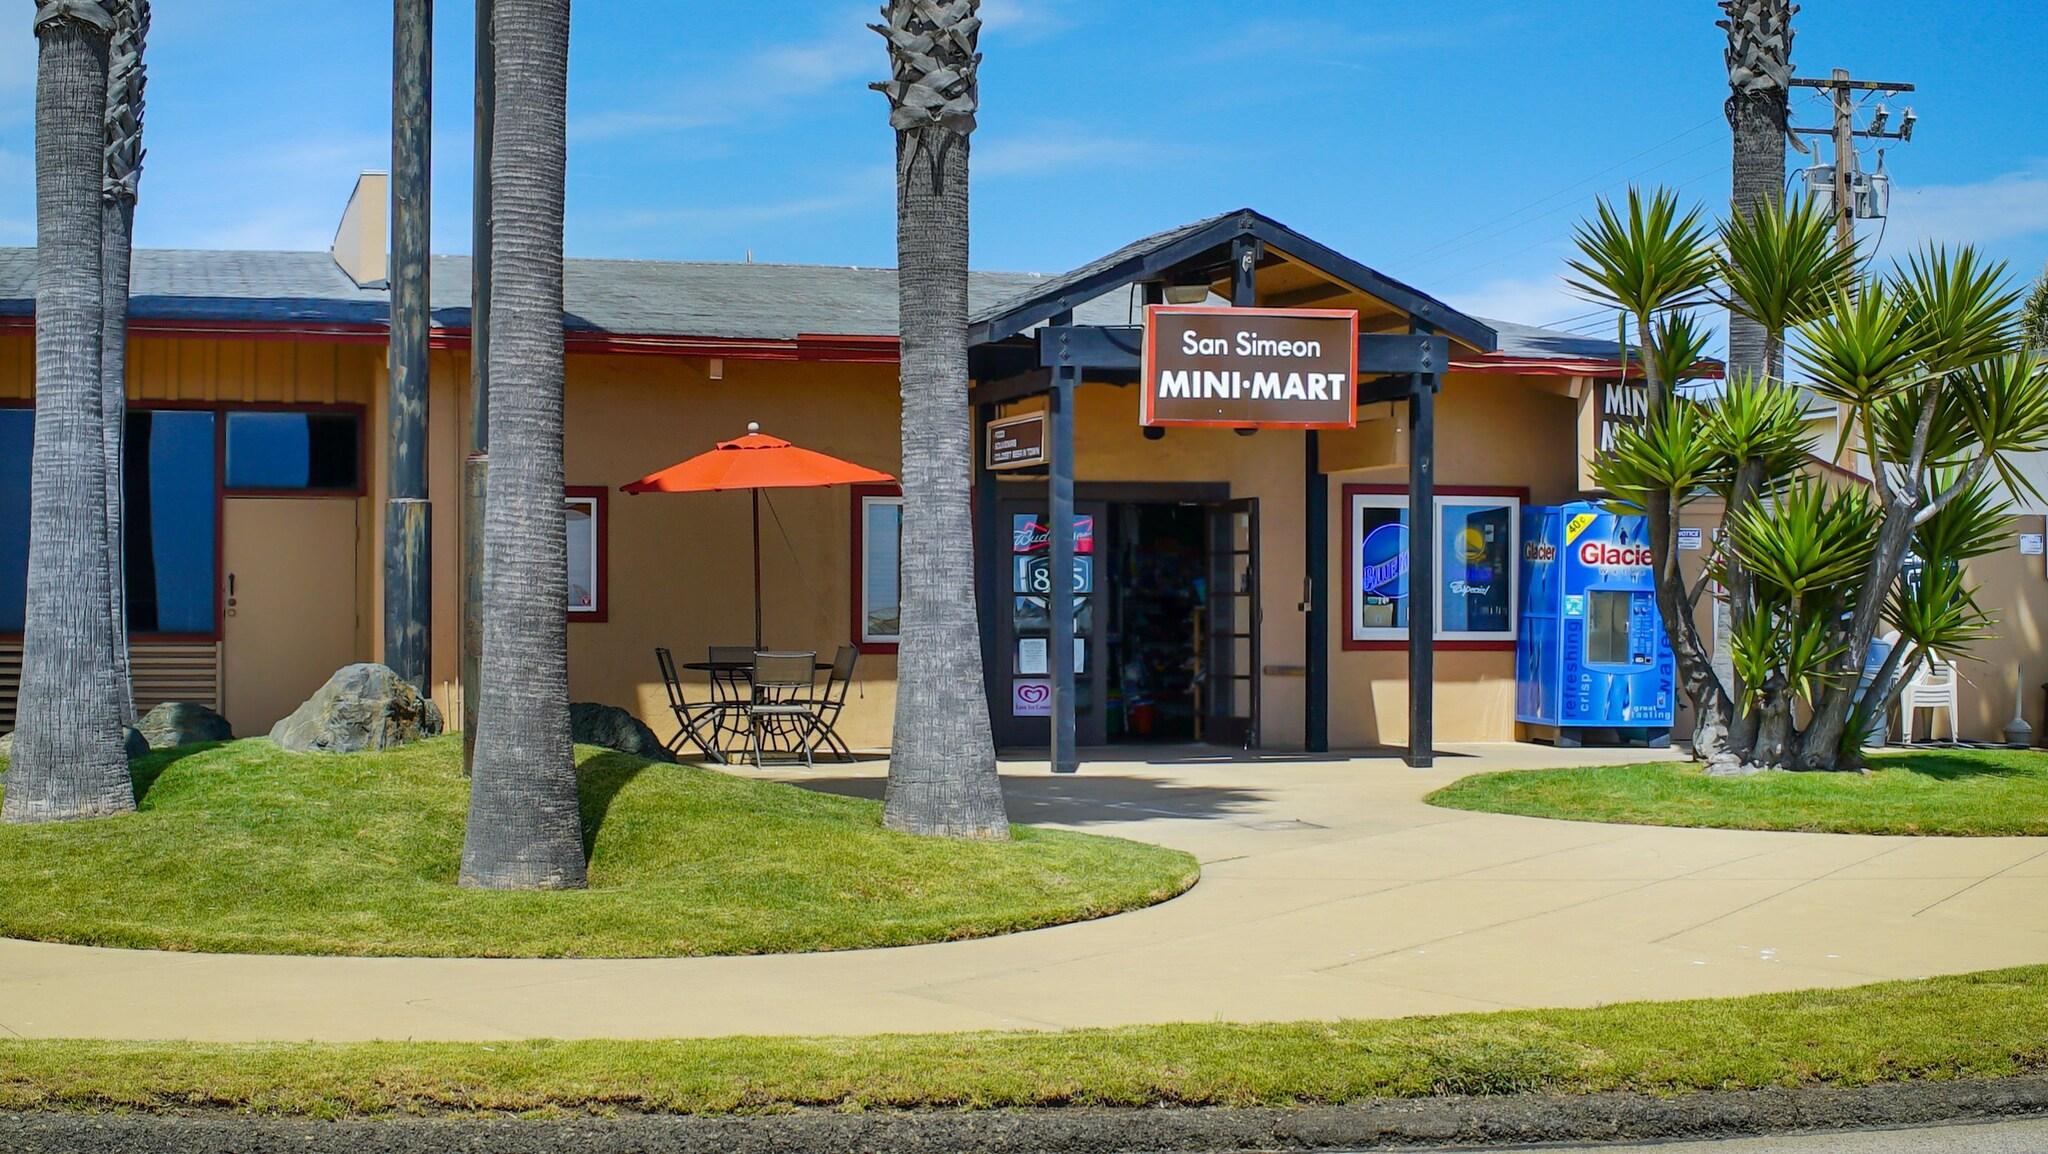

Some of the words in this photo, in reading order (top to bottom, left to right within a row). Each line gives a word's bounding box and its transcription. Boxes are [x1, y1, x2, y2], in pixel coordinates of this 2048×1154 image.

[1182, 330, 1228, 356] San
[1236, 331, 1321, 358] Simeon
[1605, 383, 1649, 418] MIN
[1526, 541, 1556, 561] Glacier
[1580, 542, 1653, 566] Glacie
[1033, 568, 1085, 590] 85
[1564, 621, 1580, 717] refreshing
[1658, 636, 1672, 695] wate
[1579, 674, 1592, 712] crisp
